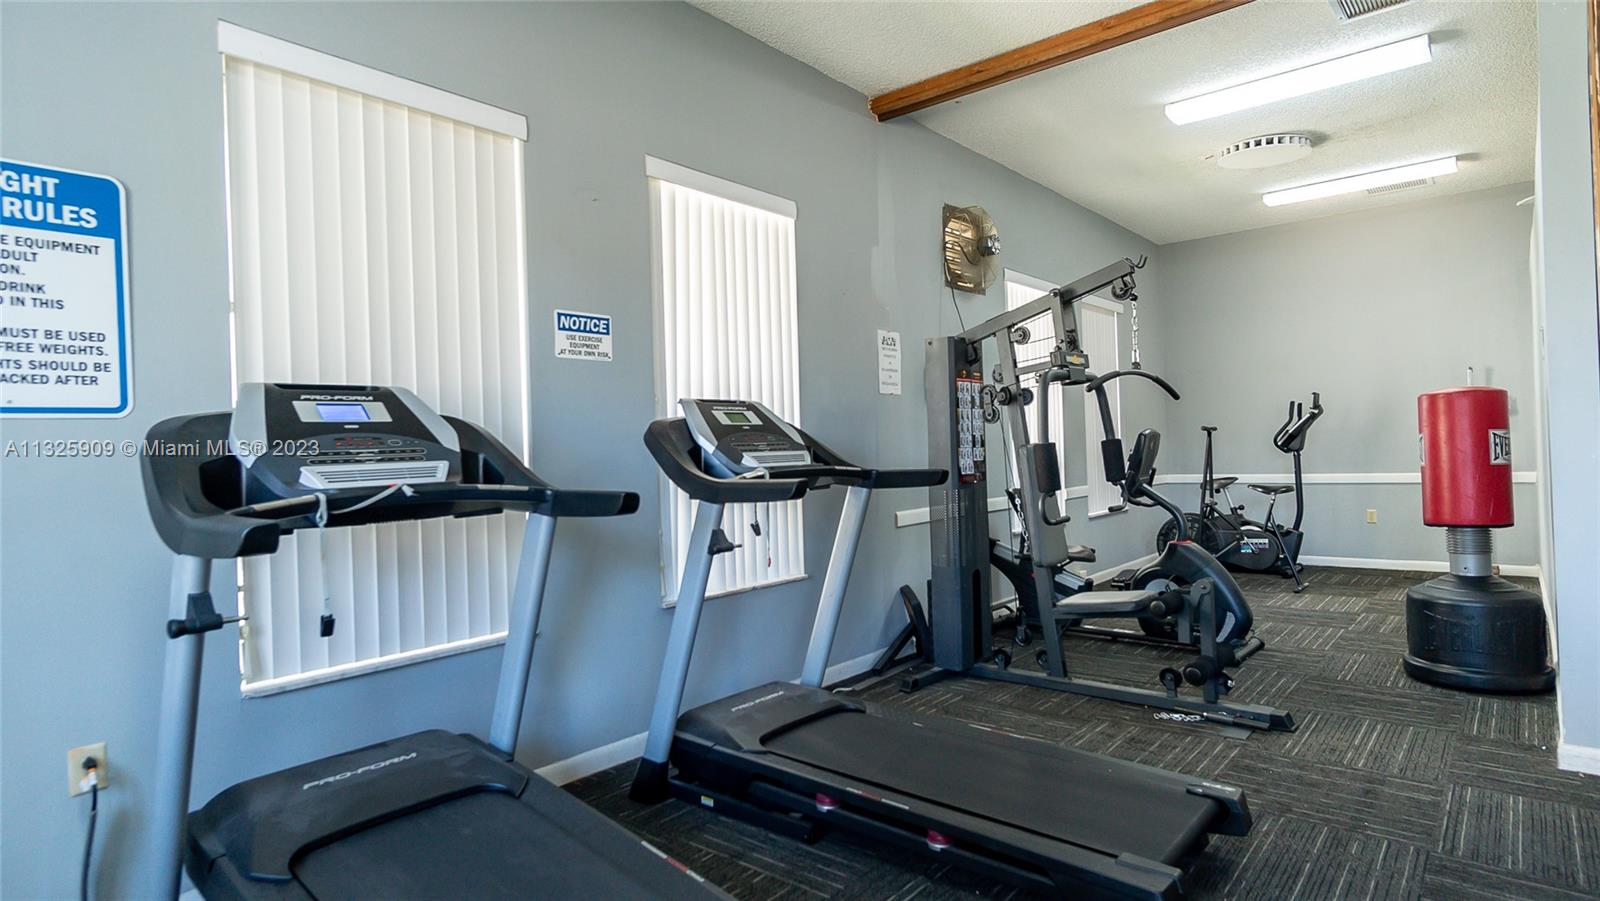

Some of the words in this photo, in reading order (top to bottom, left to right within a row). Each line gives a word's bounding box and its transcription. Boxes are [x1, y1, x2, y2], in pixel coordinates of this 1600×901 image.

[0, 170, 60, 198] GHT
[2, 196, 98, 228] RULES
[15, 236, 101, 256] EQUIPMENT
[0, 248, 38, 262] DULT
[0, 280, 46, 294] DRINK
[10, 295, 26, 307] IN
[31, 297, 65, 310] THIS
[559, 315, 608, 333] NOTICE
[44, 329, 64, 341] BE
[69, 331, 106, 343] USED
[578, 335, 603, 343] EXERCISE
[39, 343, 109, 356] WEIGHTS.
[569, 341, 600, 350] EQUIPMENT
[28, 360, 88, 372] SHOULD
[93, 362, 112, 373] BE
[55, 374, 99, 386] AFTER
[302, 752, 418, 790] PRO-FORM
